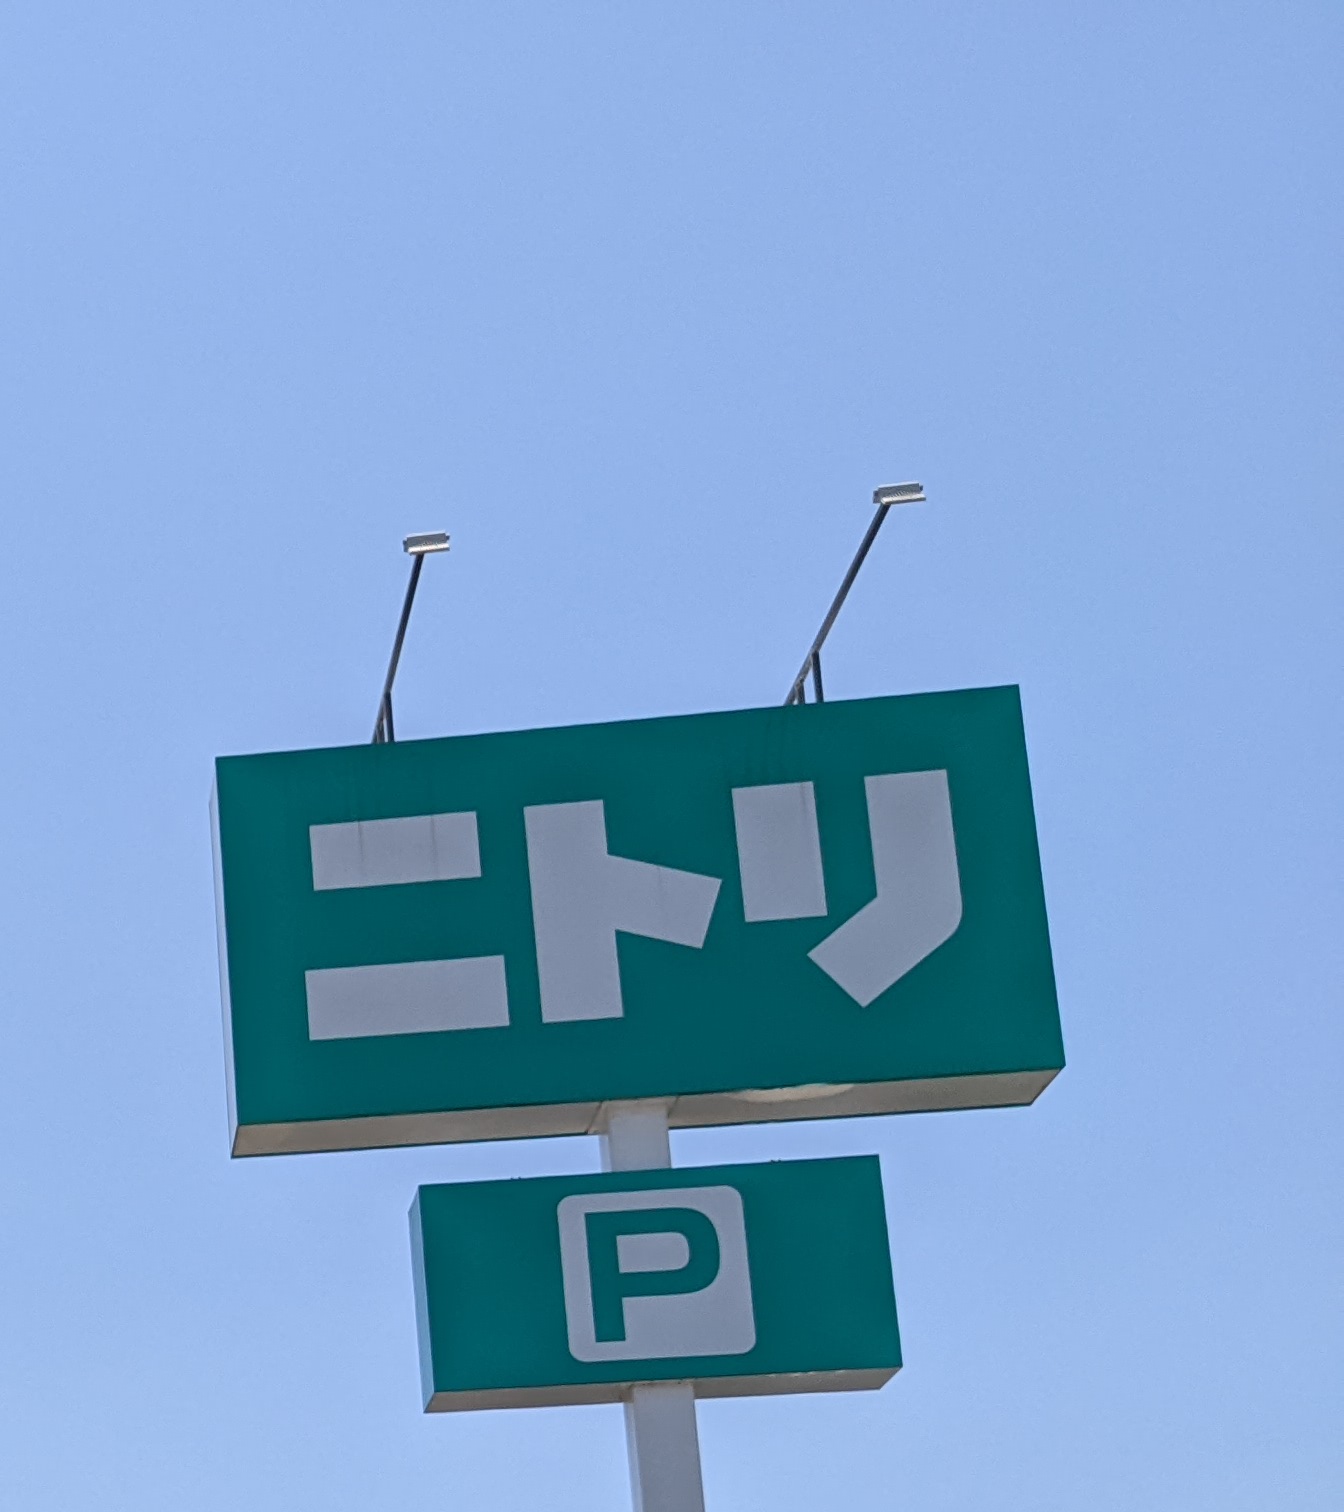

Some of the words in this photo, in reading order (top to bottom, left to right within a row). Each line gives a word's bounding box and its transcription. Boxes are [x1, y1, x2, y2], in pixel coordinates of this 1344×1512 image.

[304, 768, 963, 1041] ニトリ
[584, 1206, 721, 1344] P
